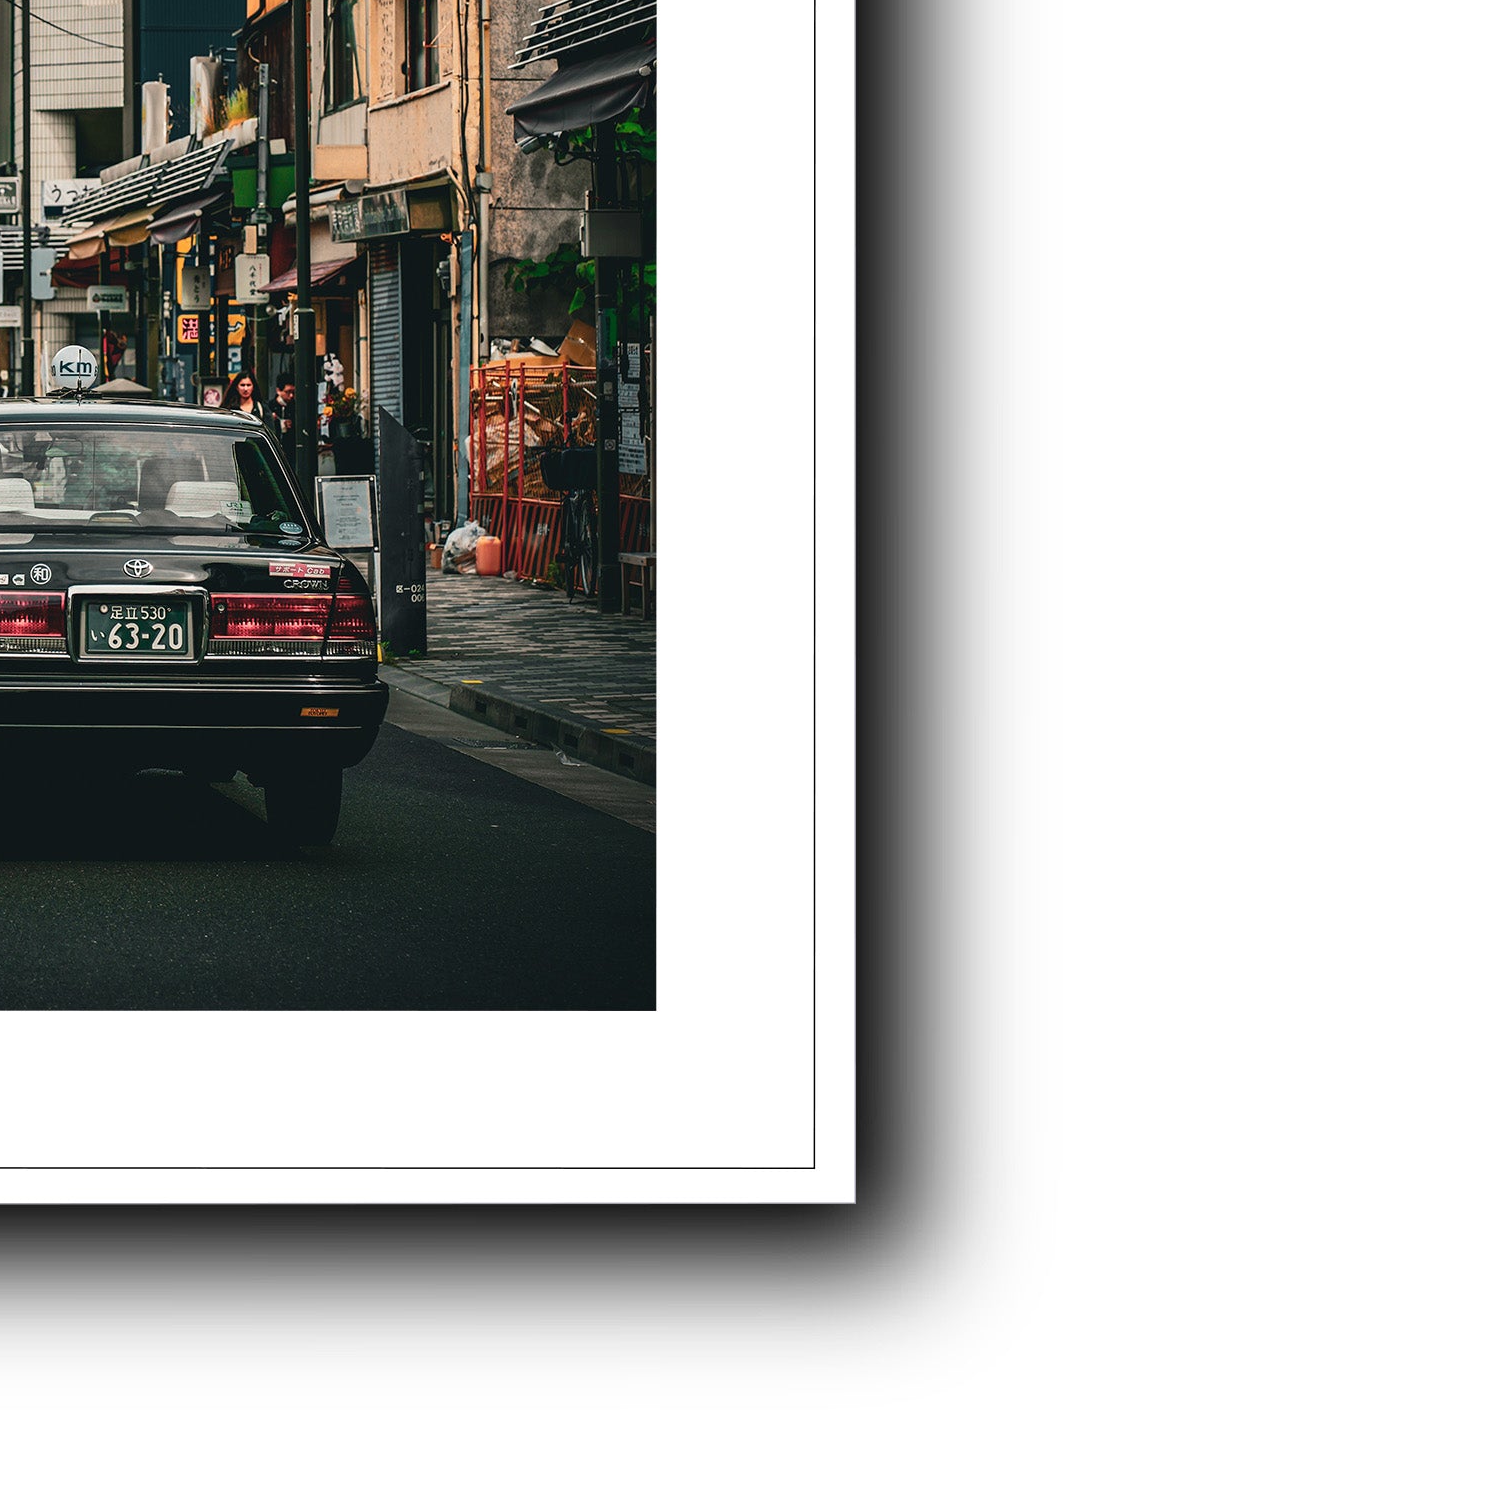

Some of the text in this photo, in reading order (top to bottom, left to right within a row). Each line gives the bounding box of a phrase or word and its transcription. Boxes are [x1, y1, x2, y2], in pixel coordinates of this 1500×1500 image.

[32, 566, 50, 582] 和
[275, 566, 325, 575] サポート Cab
[283, 580, 329, 591] CROWN
[108, 622, 183, 650] 63-20
